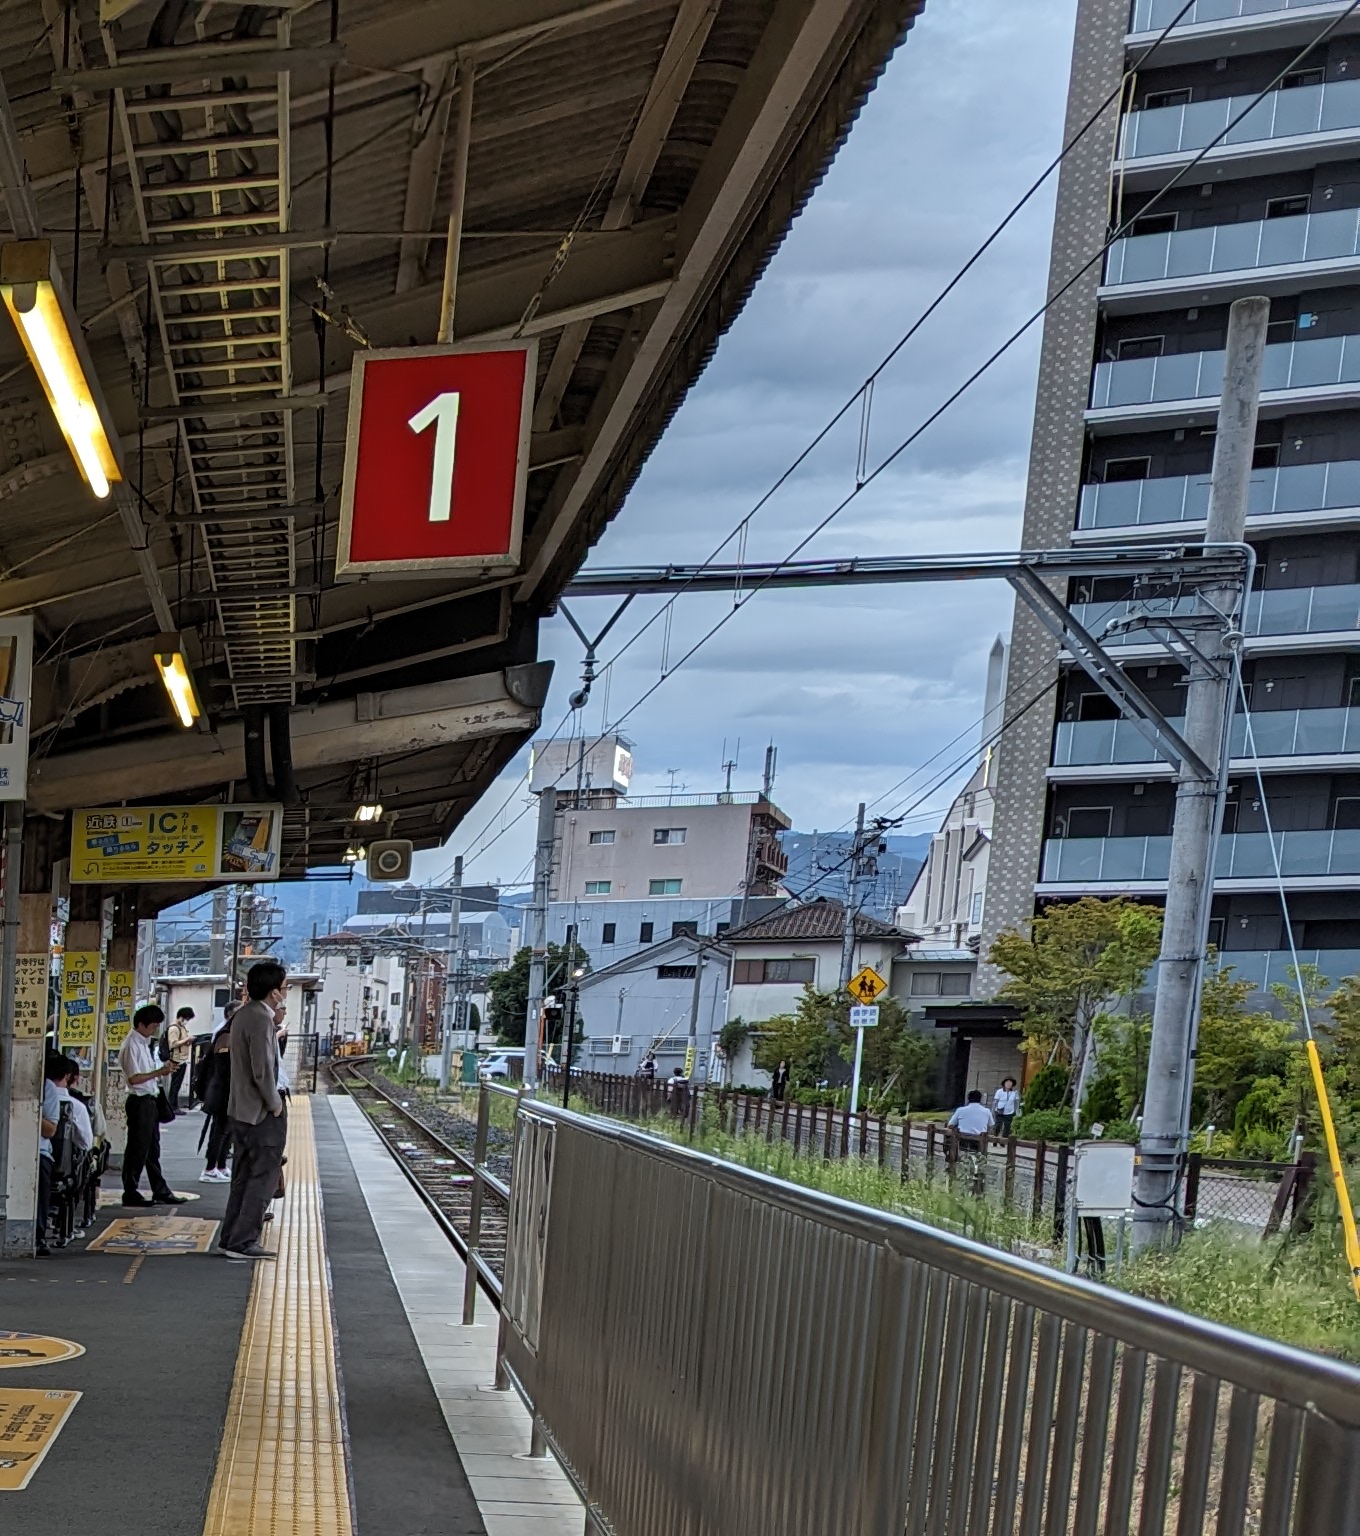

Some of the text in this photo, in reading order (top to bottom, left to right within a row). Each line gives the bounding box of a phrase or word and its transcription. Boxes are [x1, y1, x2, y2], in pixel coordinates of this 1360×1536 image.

[408, 391, 460, 521] 1
[86, 814, 117, 830] 近鉄
[148, 812, 178, 834] IC
